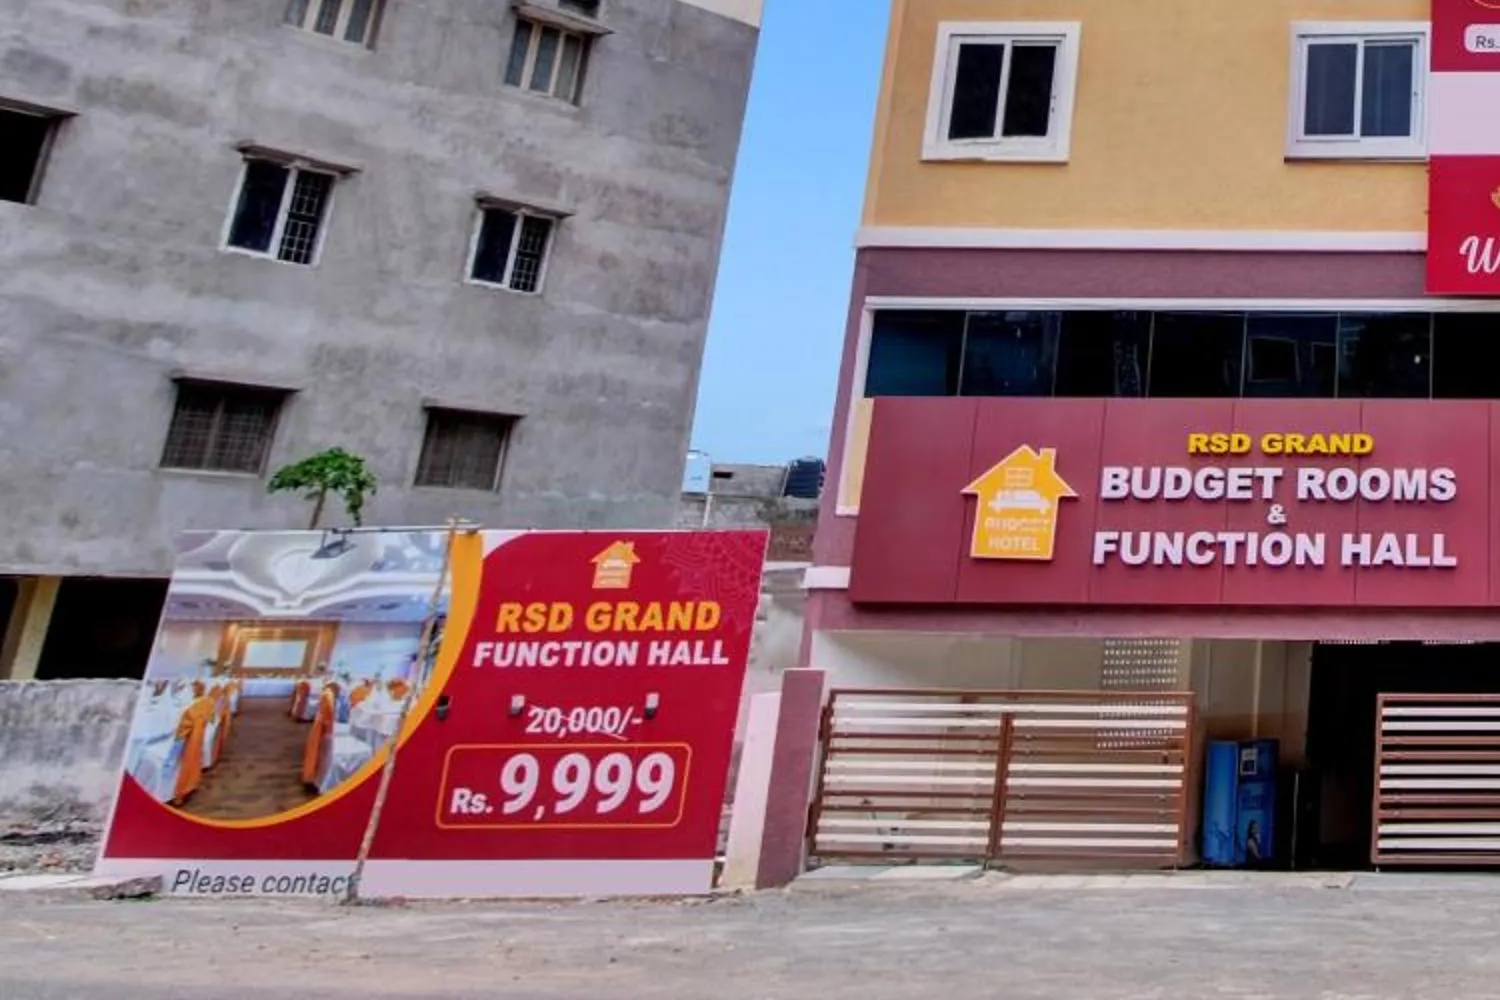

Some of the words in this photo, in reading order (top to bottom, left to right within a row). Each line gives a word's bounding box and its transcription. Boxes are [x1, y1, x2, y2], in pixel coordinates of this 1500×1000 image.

[1475, 36, 1500, 48] Rs.
[1188, 433, 1251, 454] RSD
[1261, 433, 1374, 455] GRAND
[1101, 467, 1283, 501] BUDGET
[1296, 467, 1456, 502] ROOMS
[1267, 504, 1287, 525] &
[1092, 532, 1325, 567] FUNCTION
[1341, 533, 1457, 567] HALL
[496, 602, 574, 633] RSD
[584, 601, 721, 632] GRAND
[473, 641, 639, 668] FUNCTION
[647, 641, 730, 666] HALL
[525, 706, 643, 739] 20,000/-
[450, 788, 494, 814] Rs.
[500, 752, 675, 821] 9,999
[171, 869, 256, 894] Please
